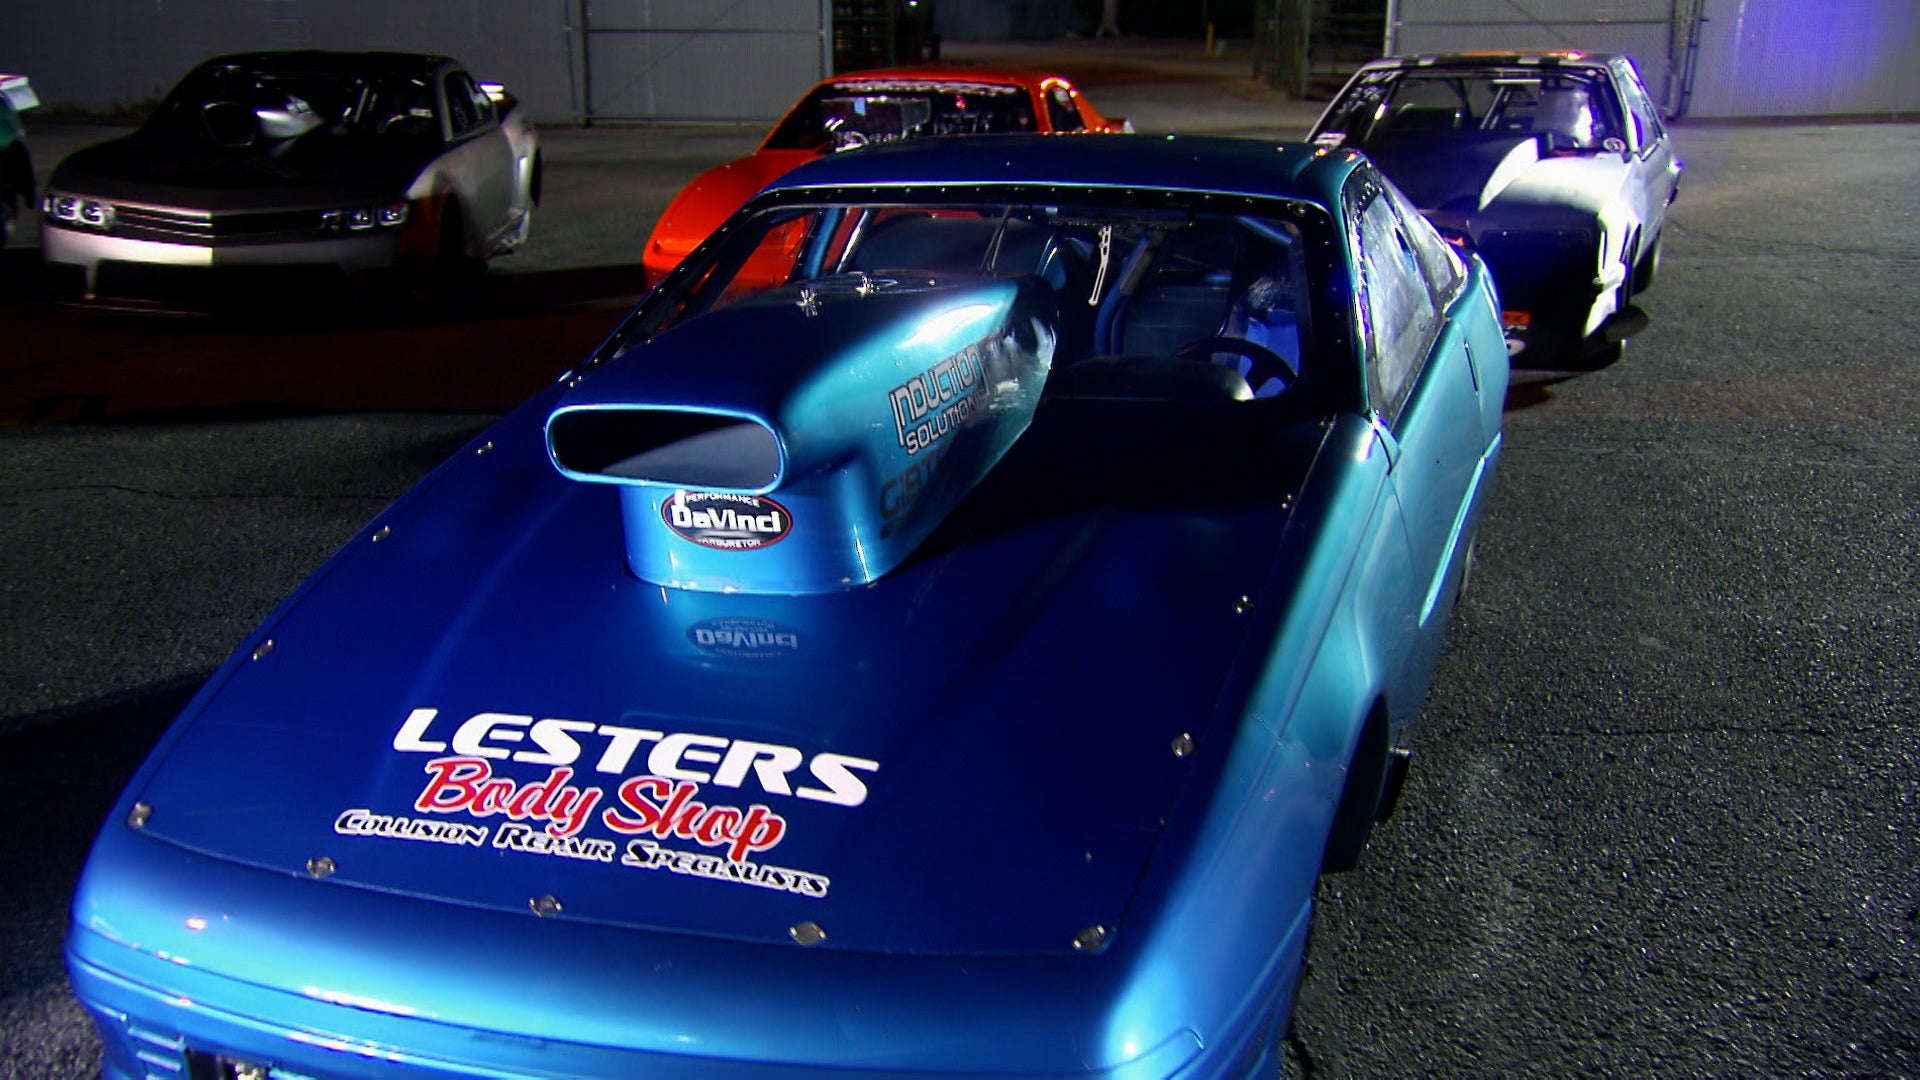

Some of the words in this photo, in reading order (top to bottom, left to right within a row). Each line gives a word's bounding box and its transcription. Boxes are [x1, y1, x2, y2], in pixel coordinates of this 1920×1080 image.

[889, 343, 988, 449] INDUCTION
[670, 505, 781, 533] DaVinci
[392, 707, 880, 807] LESTERS
[333, 809, 488, 847] COLLISION
[493, 823, 615, 864] REPAIR
[622, 839, 830, 898] SPECIALISTS
[415, 756, 602, 839] Body
[604, 776, 787, 863] Shop
